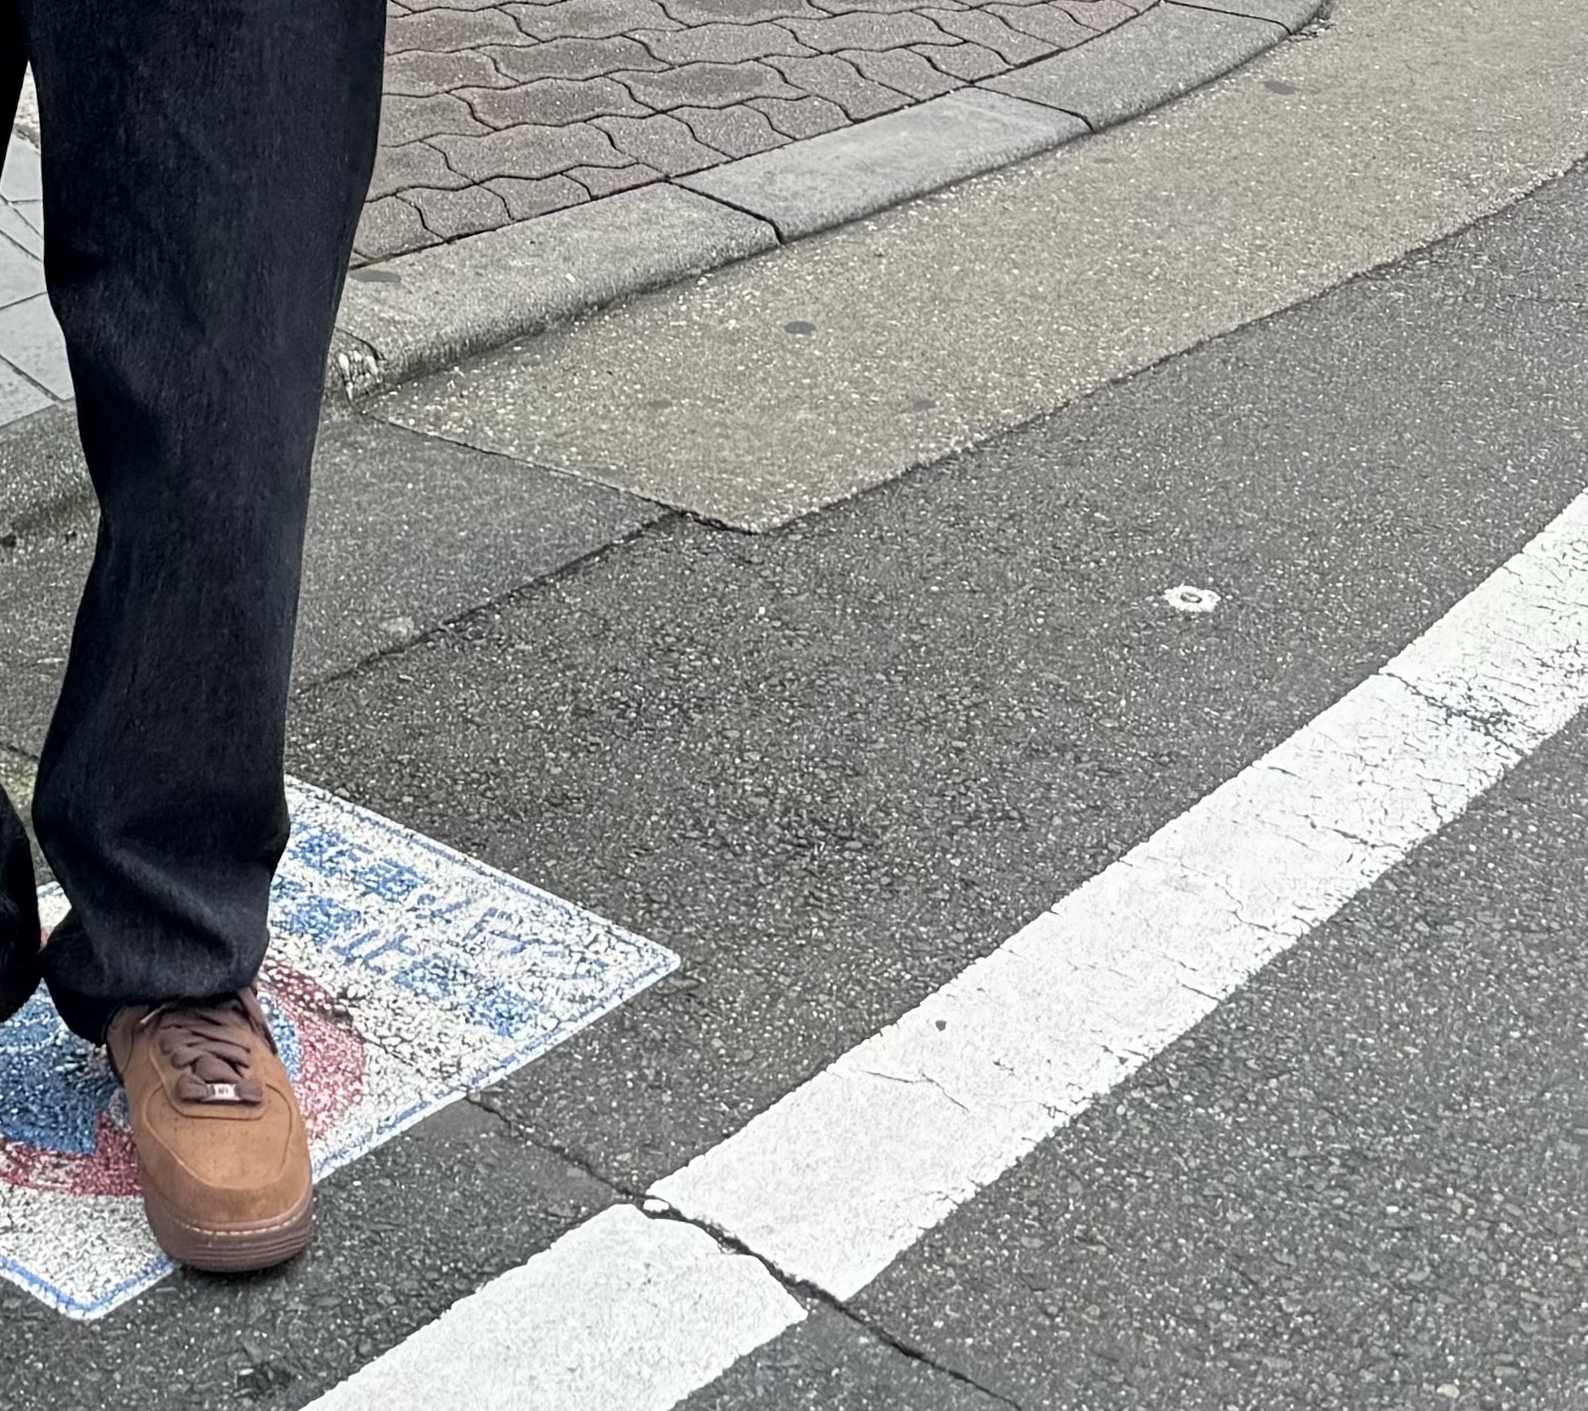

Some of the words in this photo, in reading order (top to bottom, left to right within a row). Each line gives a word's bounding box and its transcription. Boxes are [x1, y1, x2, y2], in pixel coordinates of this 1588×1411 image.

[286, 819, 617, 992] 転車・バイク
